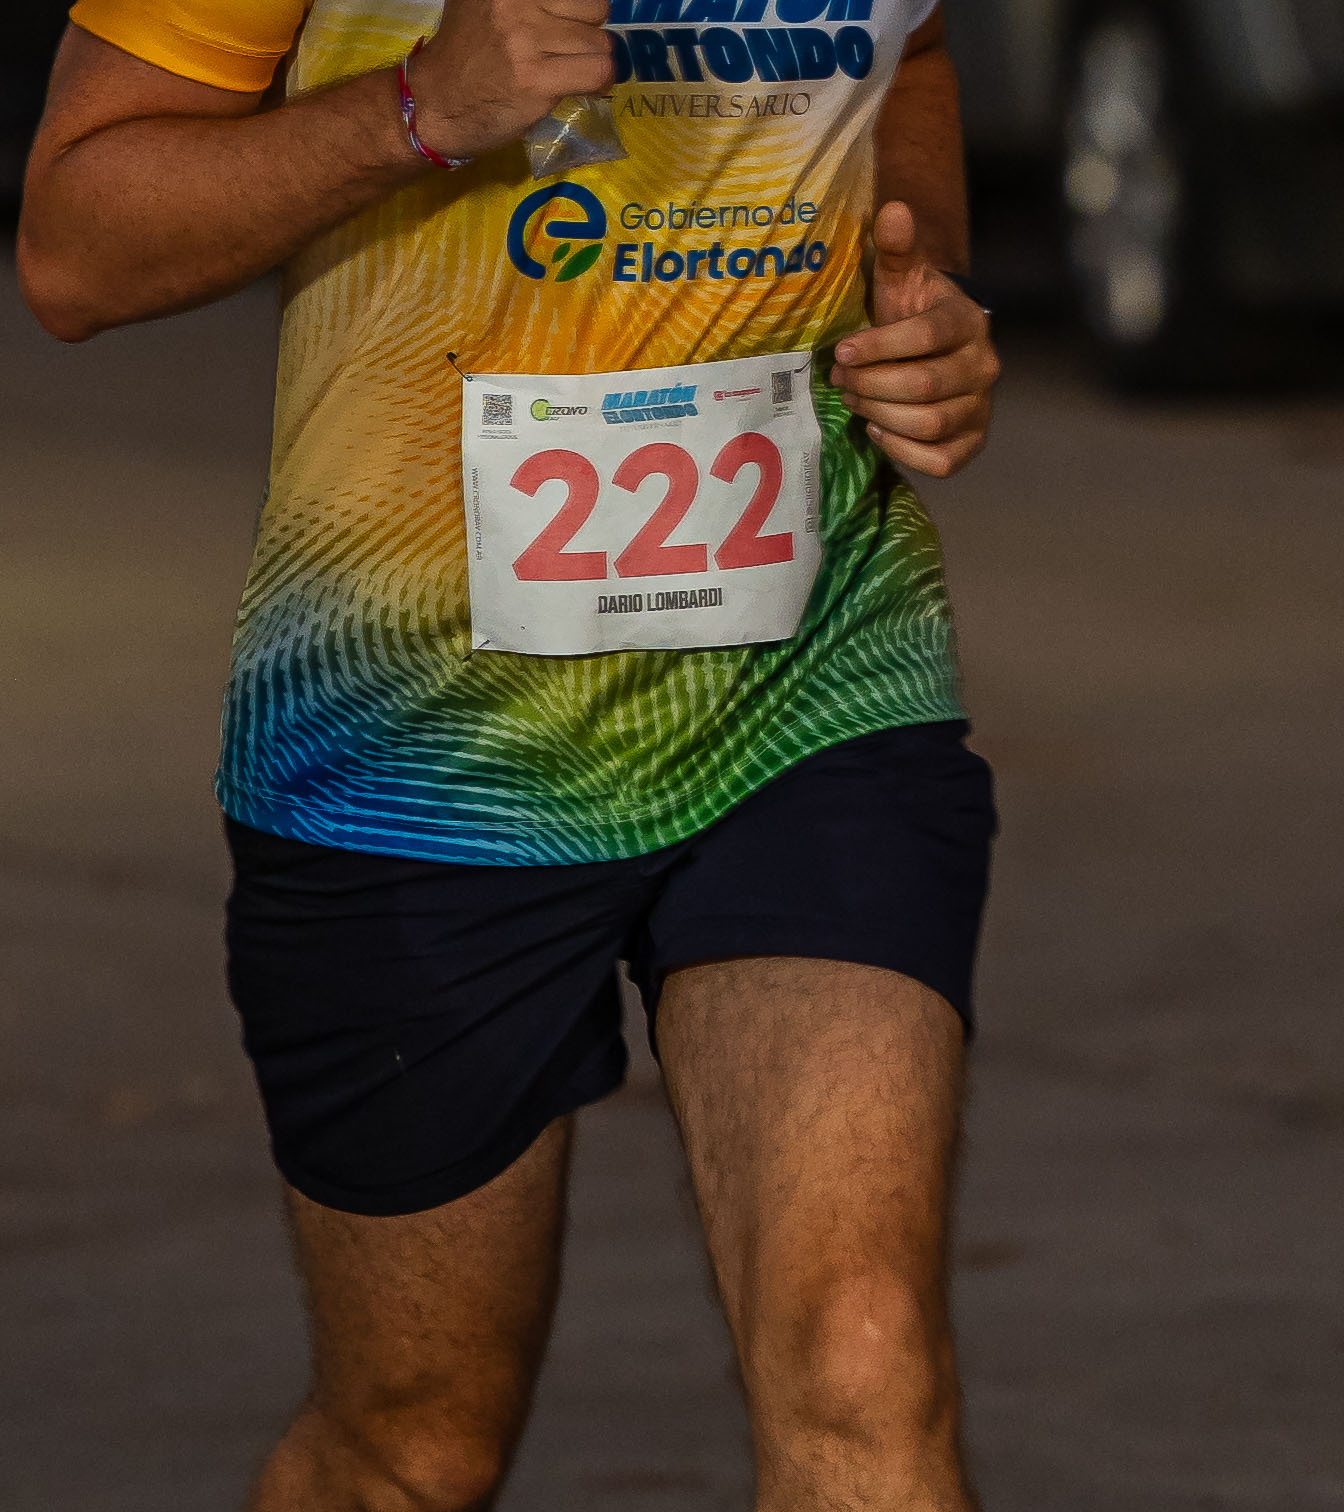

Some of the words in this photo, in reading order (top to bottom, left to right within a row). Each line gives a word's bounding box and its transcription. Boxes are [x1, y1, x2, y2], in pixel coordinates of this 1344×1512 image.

[607, 26, 874, 83] RTONDO
[620, 92, 811, 118] ANIVERSARIO
[620, 201, 774, 230] Gobierno
[779, 197, 817, 225] de
[612, 240, 828, 282] Elortondo
[510, 432, 794, 581] 222
[597, 594, 643, 614] DARIO
[647, 587, 723, 612] LOMBARDI
